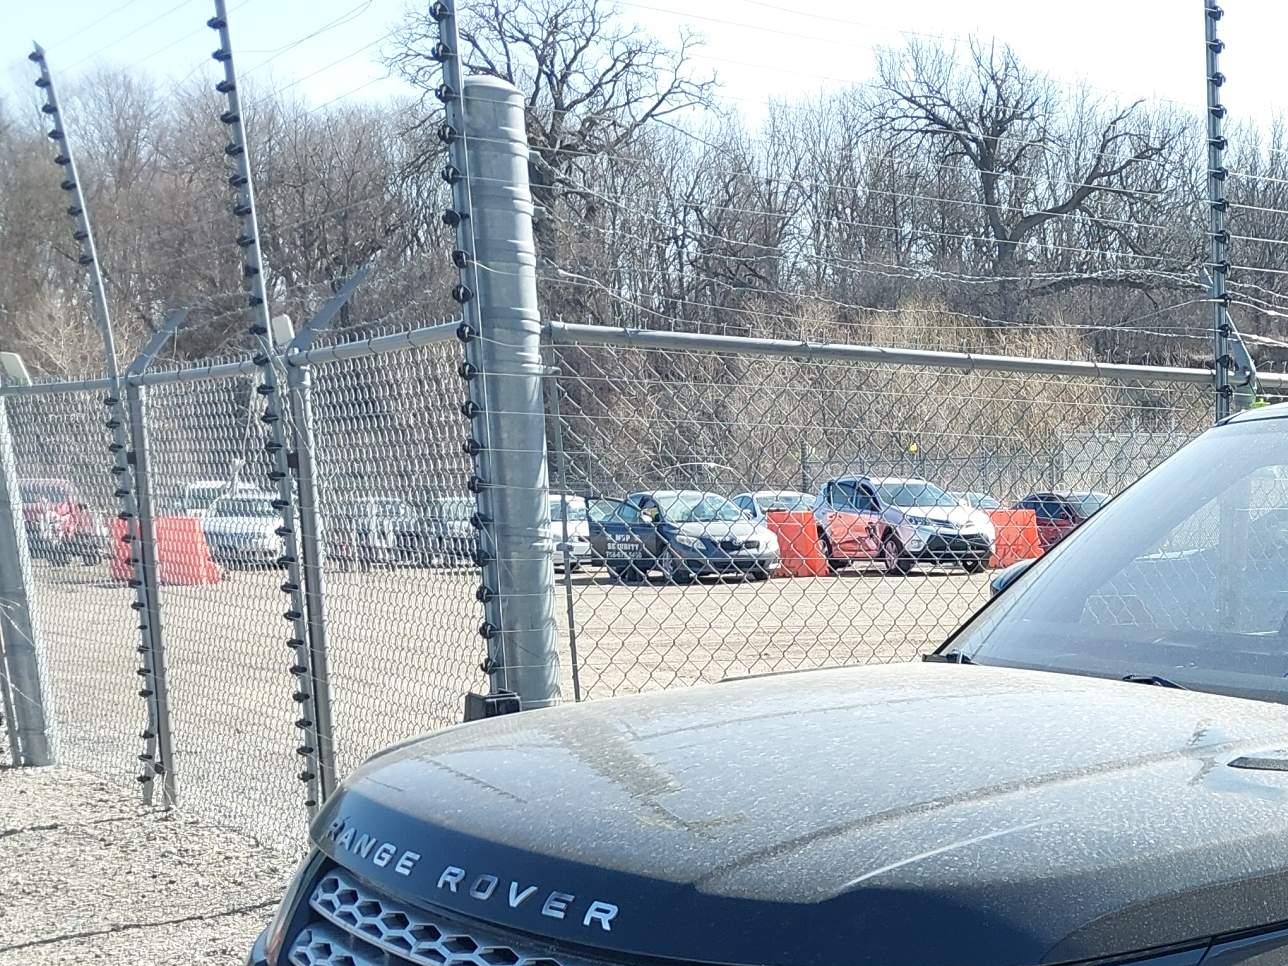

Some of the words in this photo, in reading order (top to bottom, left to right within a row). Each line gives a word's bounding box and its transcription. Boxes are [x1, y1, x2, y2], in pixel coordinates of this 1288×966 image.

[607, 543, 639, 551] SECURITY
[327, 817, 421, 876] RANGE
[436, 865, 619, 931] ROVER
